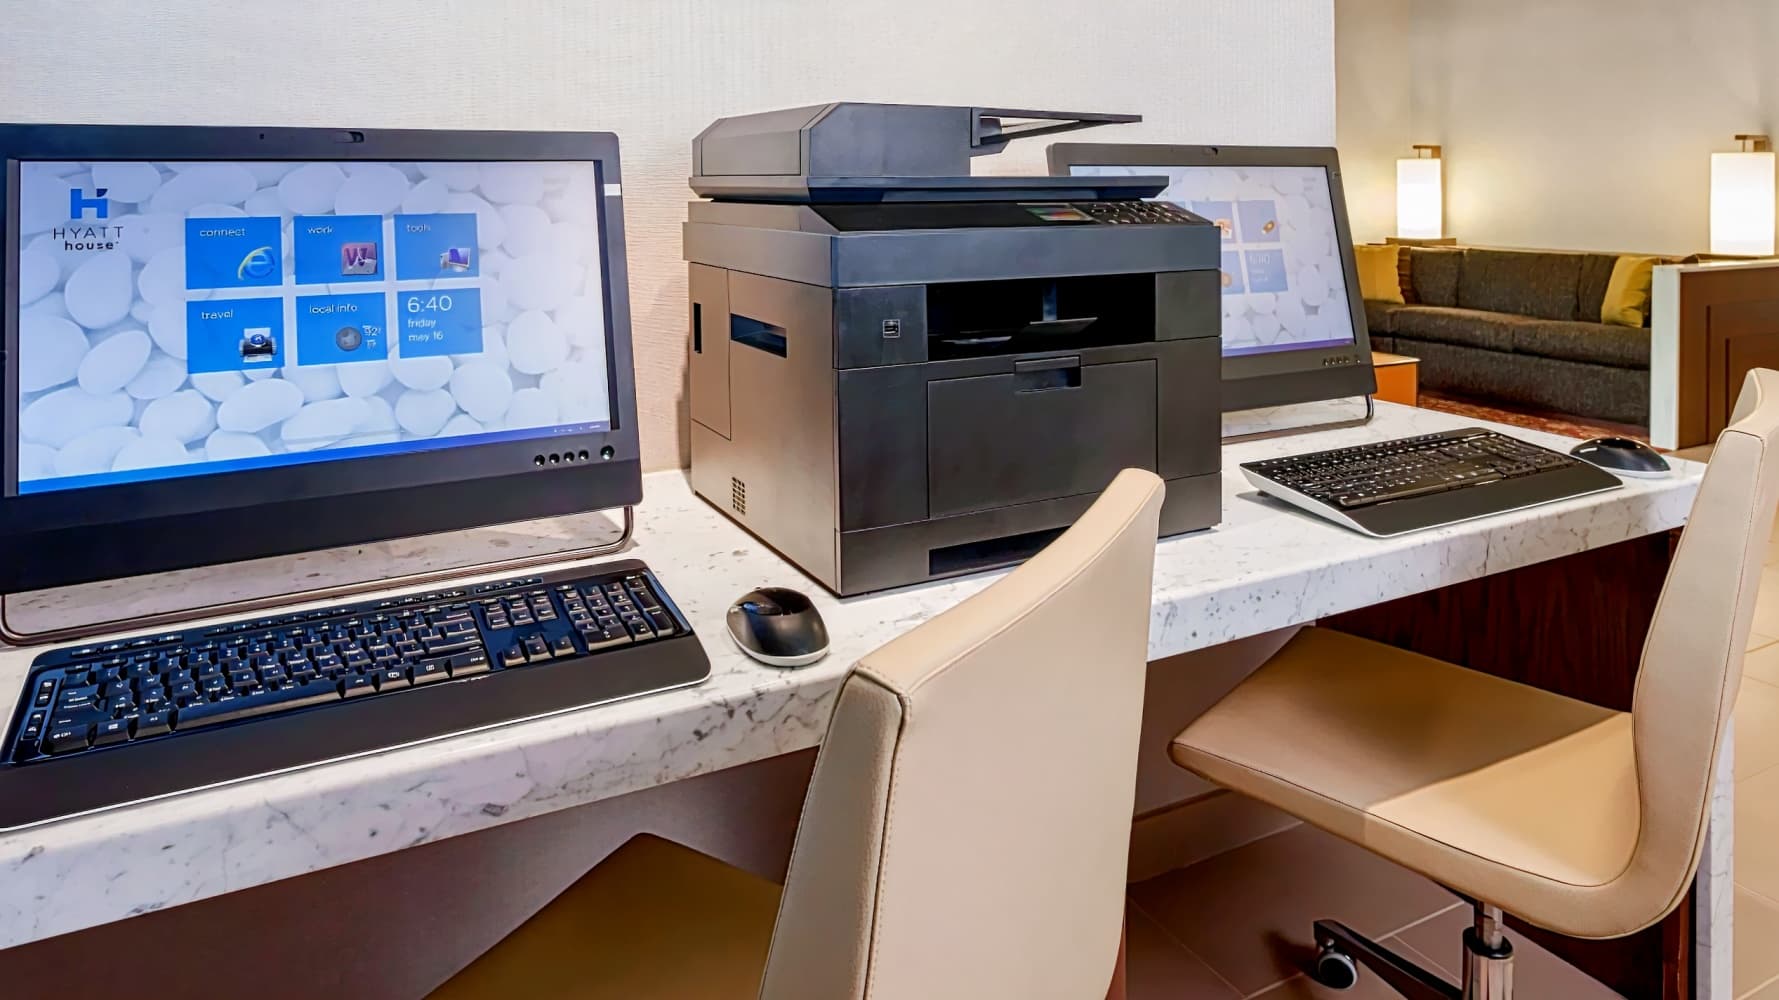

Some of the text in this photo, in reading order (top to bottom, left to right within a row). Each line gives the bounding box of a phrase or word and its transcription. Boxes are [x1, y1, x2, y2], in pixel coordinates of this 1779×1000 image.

[53, 226, 125, 241] HYATT
[199, 227, 246, 238] connect
[307, 225, 333, 234] work
[406, 223, 431, 233] tools
[64, 240, 115, 252] house
[309, 303, 358, 314] local info
[407, 295, 453, 313] 6:40
[201, 309, 233, 320] travel
[407, 319, 437, 330] friday
[408, 331, 443, 343] may 16
